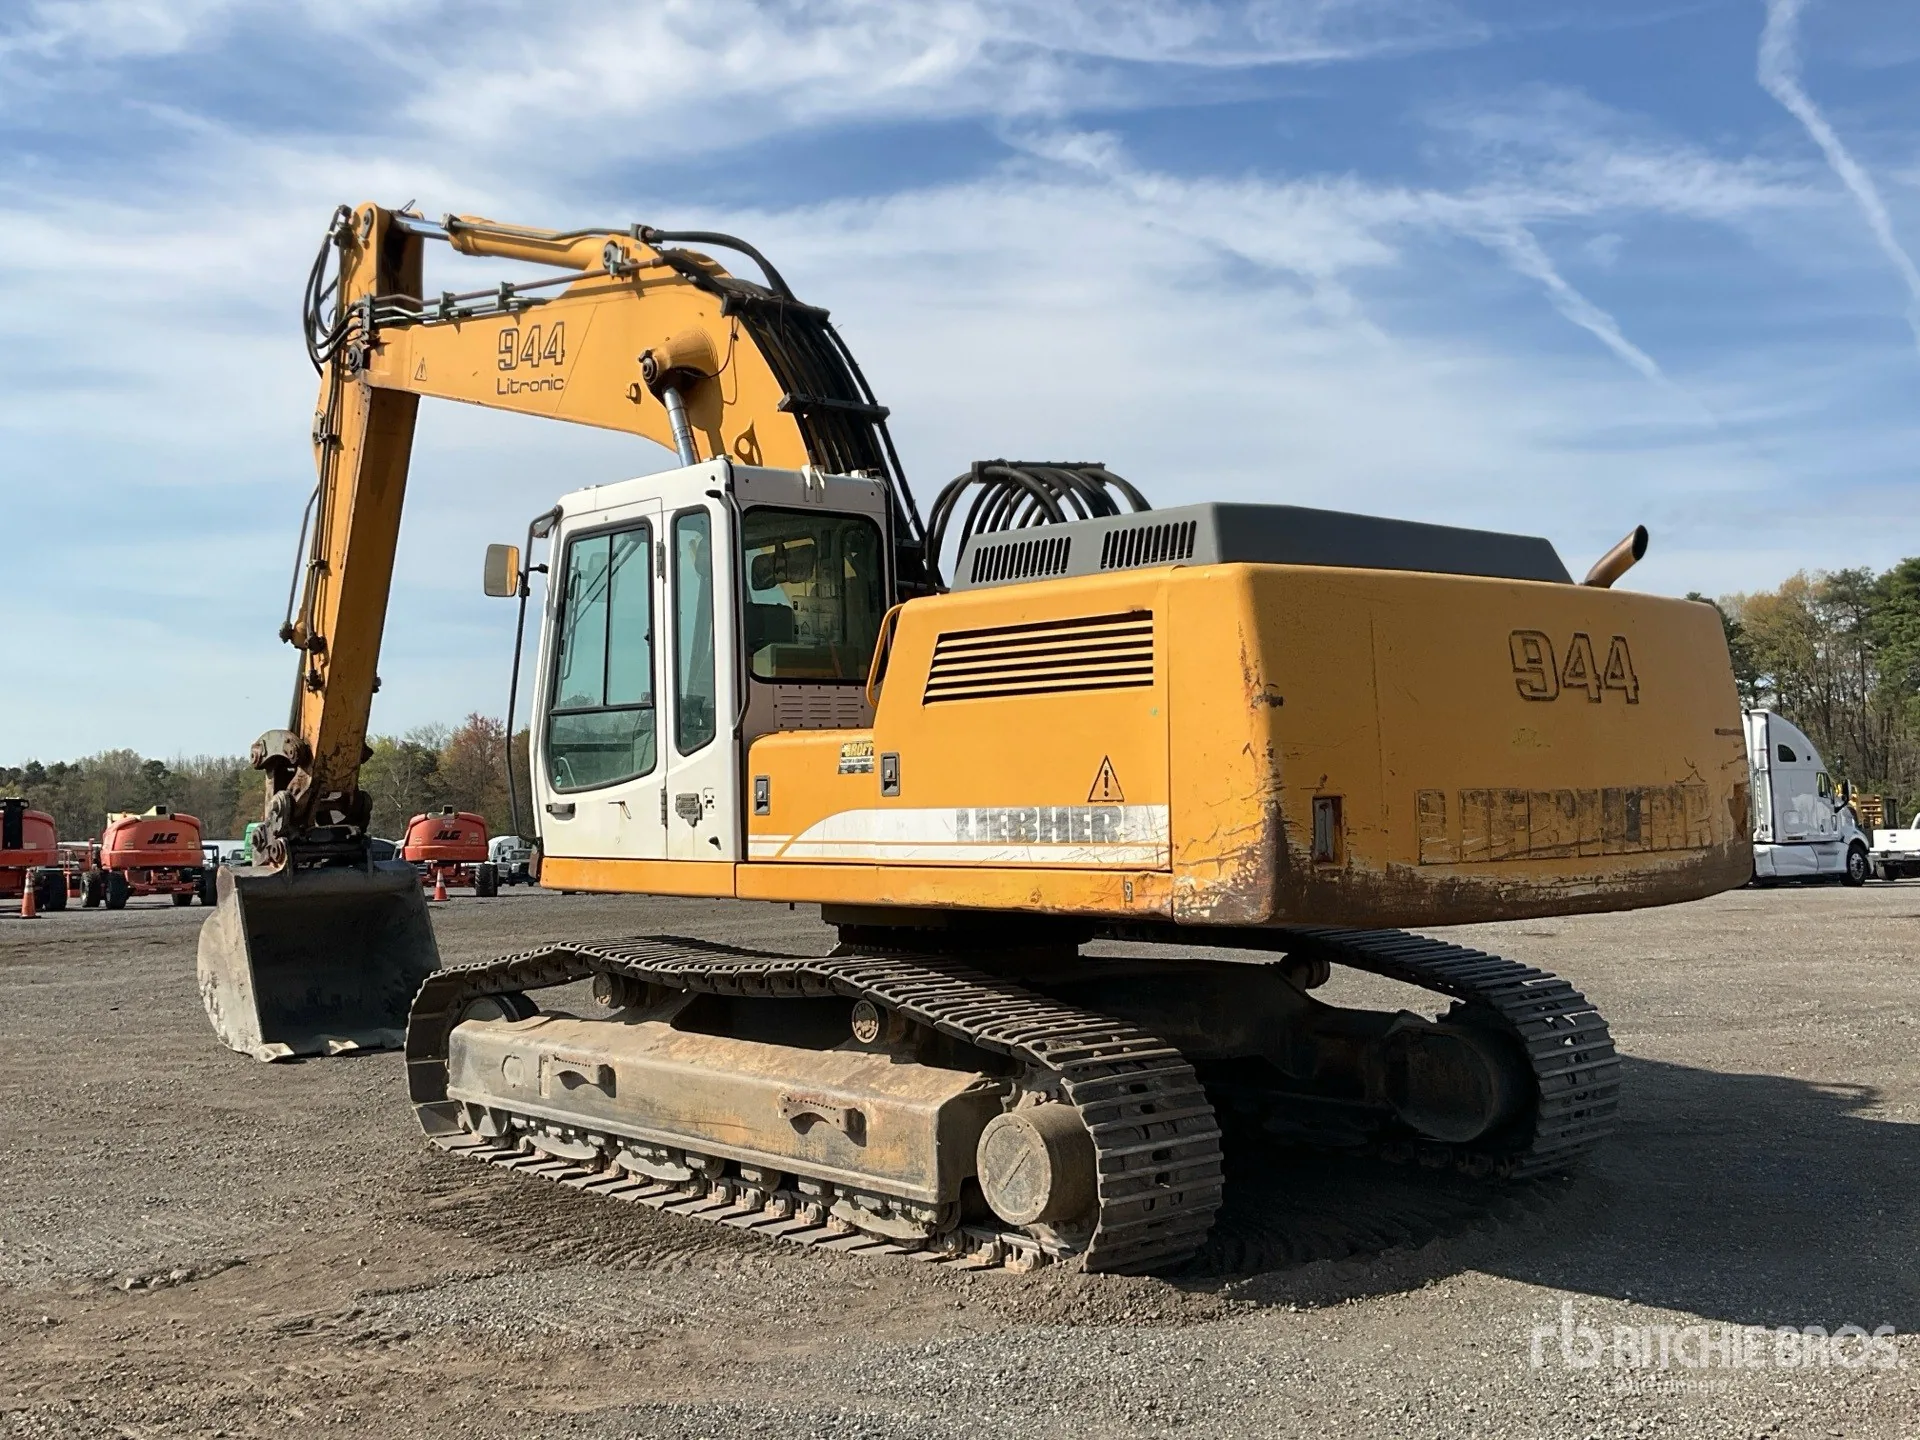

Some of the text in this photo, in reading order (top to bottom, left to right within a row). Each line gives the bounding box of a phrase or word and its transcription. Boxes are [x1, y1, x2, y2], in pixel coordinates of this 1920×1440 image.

[498, 321, 565, 371] 944
[496, 373, 565, 395] Litronic
[1508, 629, 1640, 704] 944
[147, 832, 179, 844] JLG
[433, 830, 462, 841] JLG
